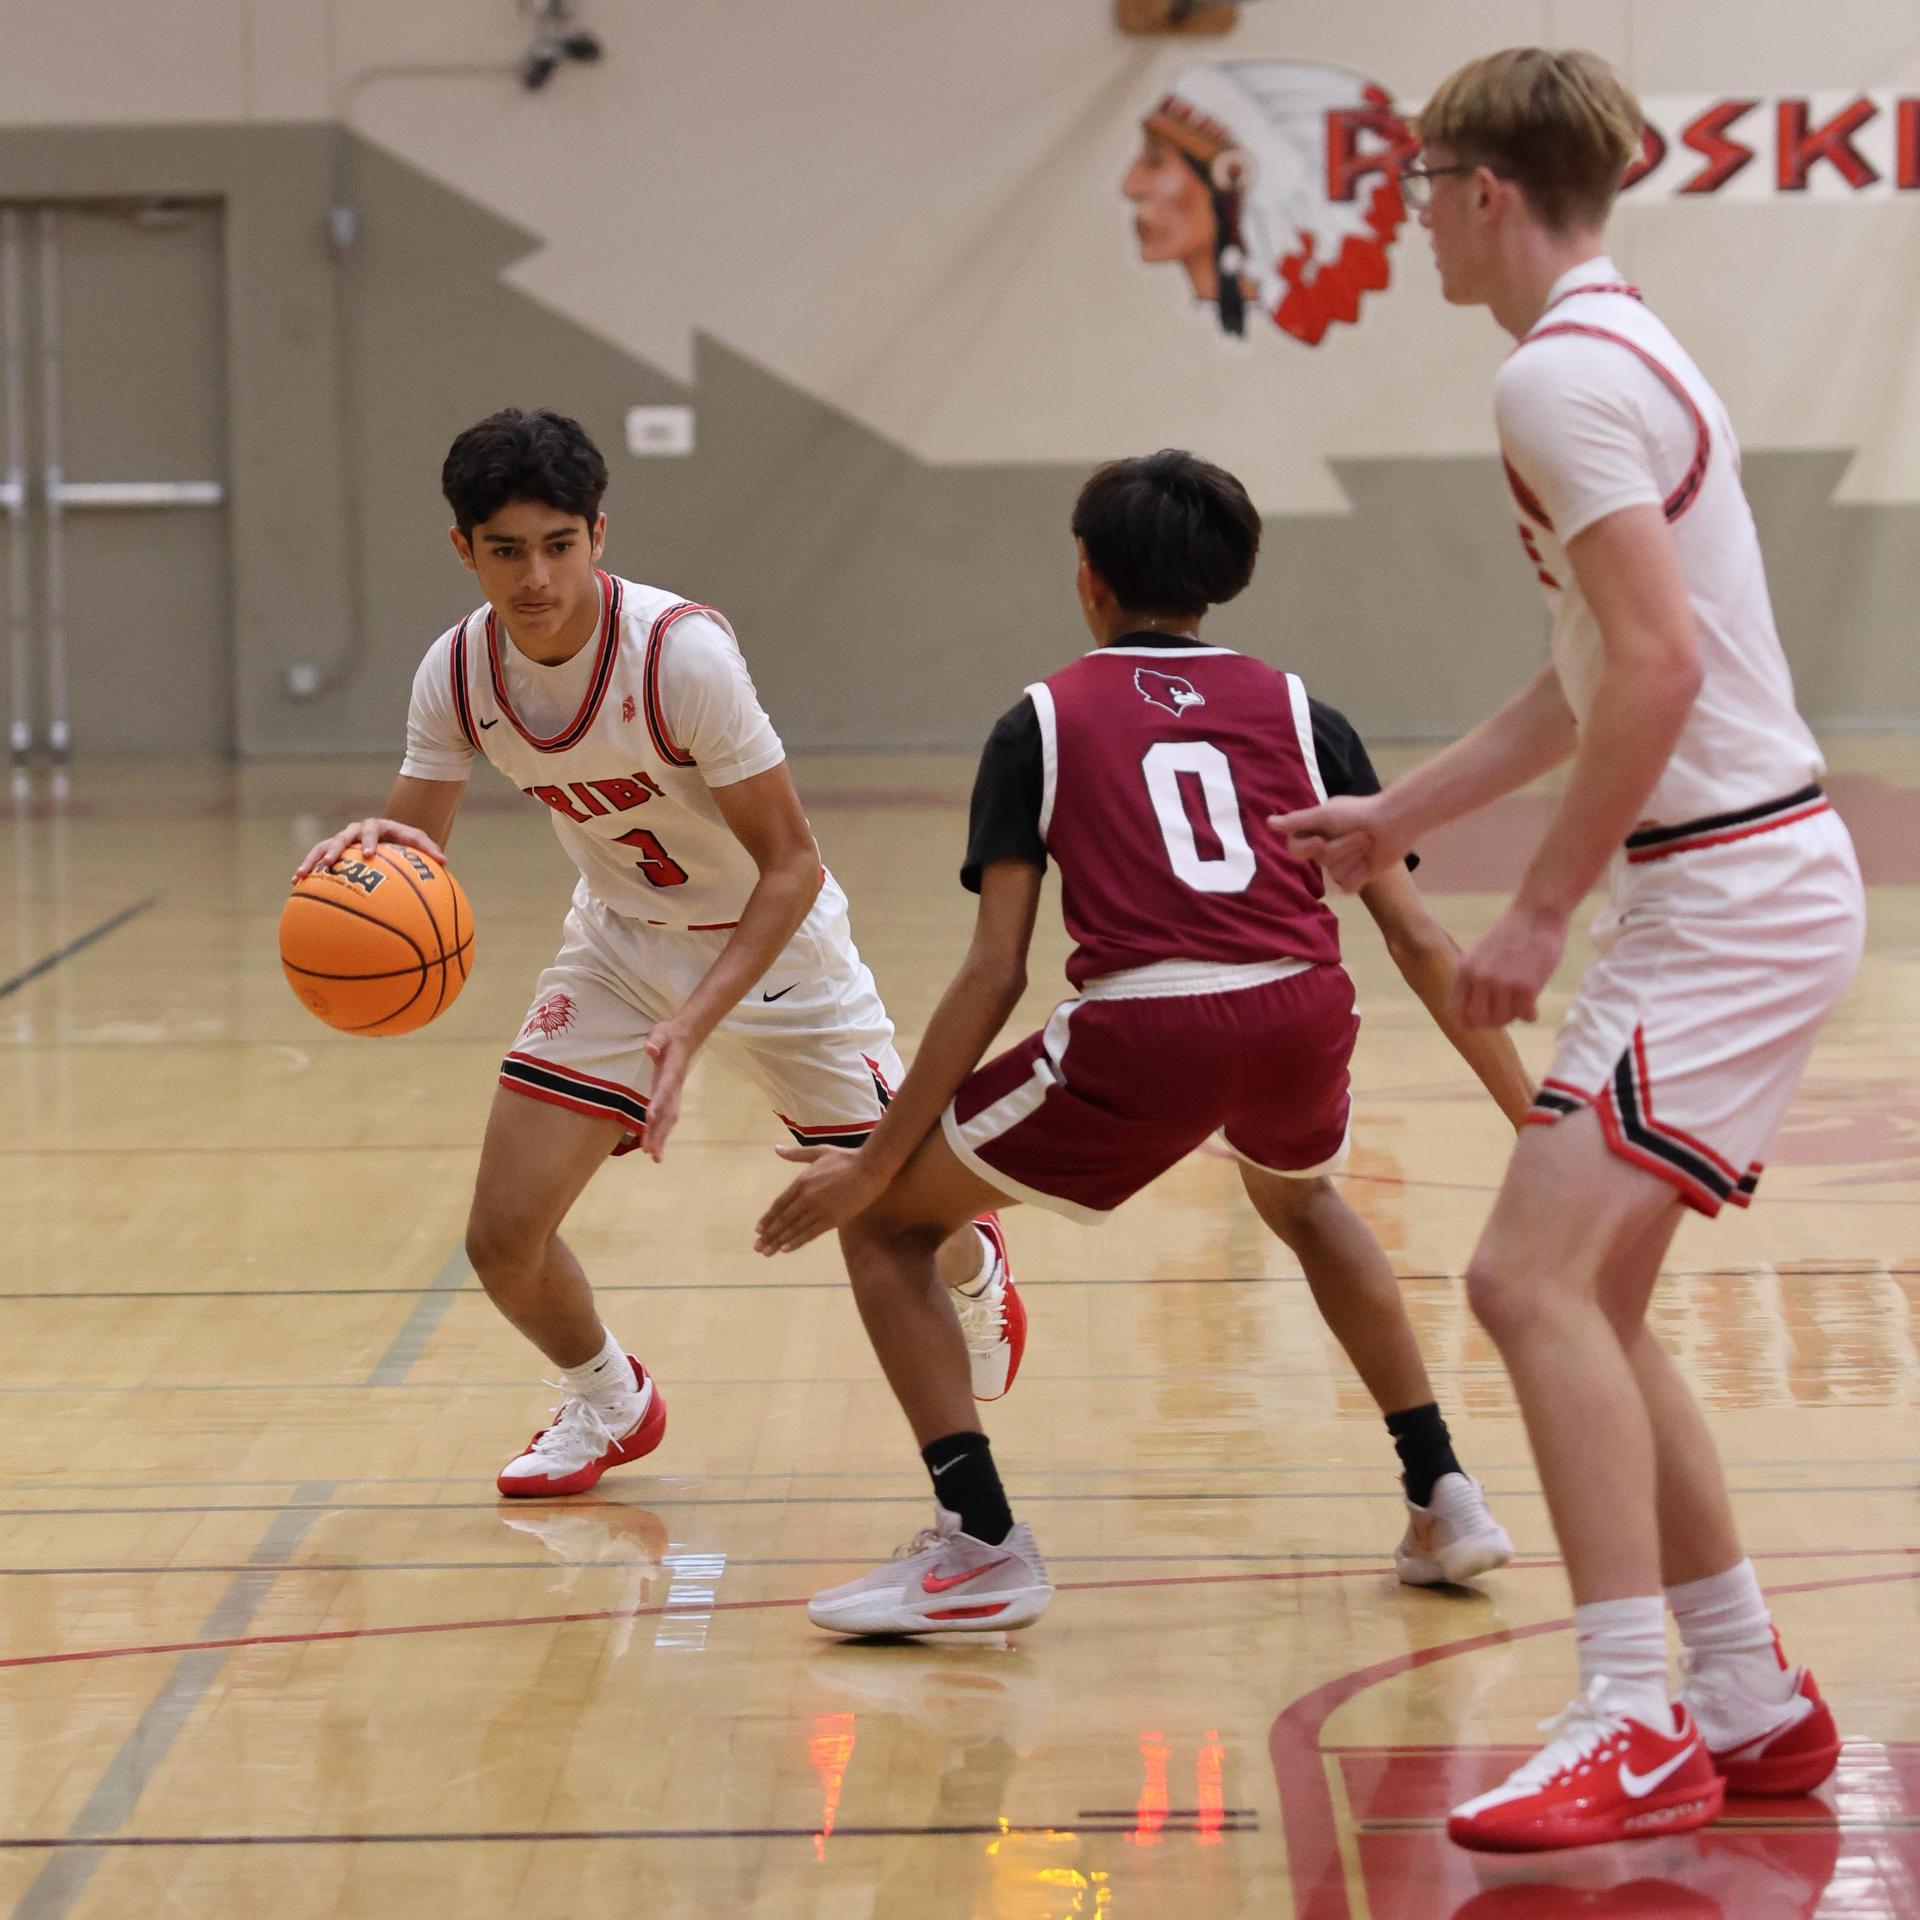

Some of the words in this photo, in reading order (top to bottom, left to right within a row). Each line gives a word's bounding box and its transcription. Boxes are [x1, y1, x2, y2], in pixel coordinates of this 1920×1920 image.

[522, 771, 667, 824] RIB
[1141, 740, 1257, 893] 0
[610, 828, 689, 887] 3
